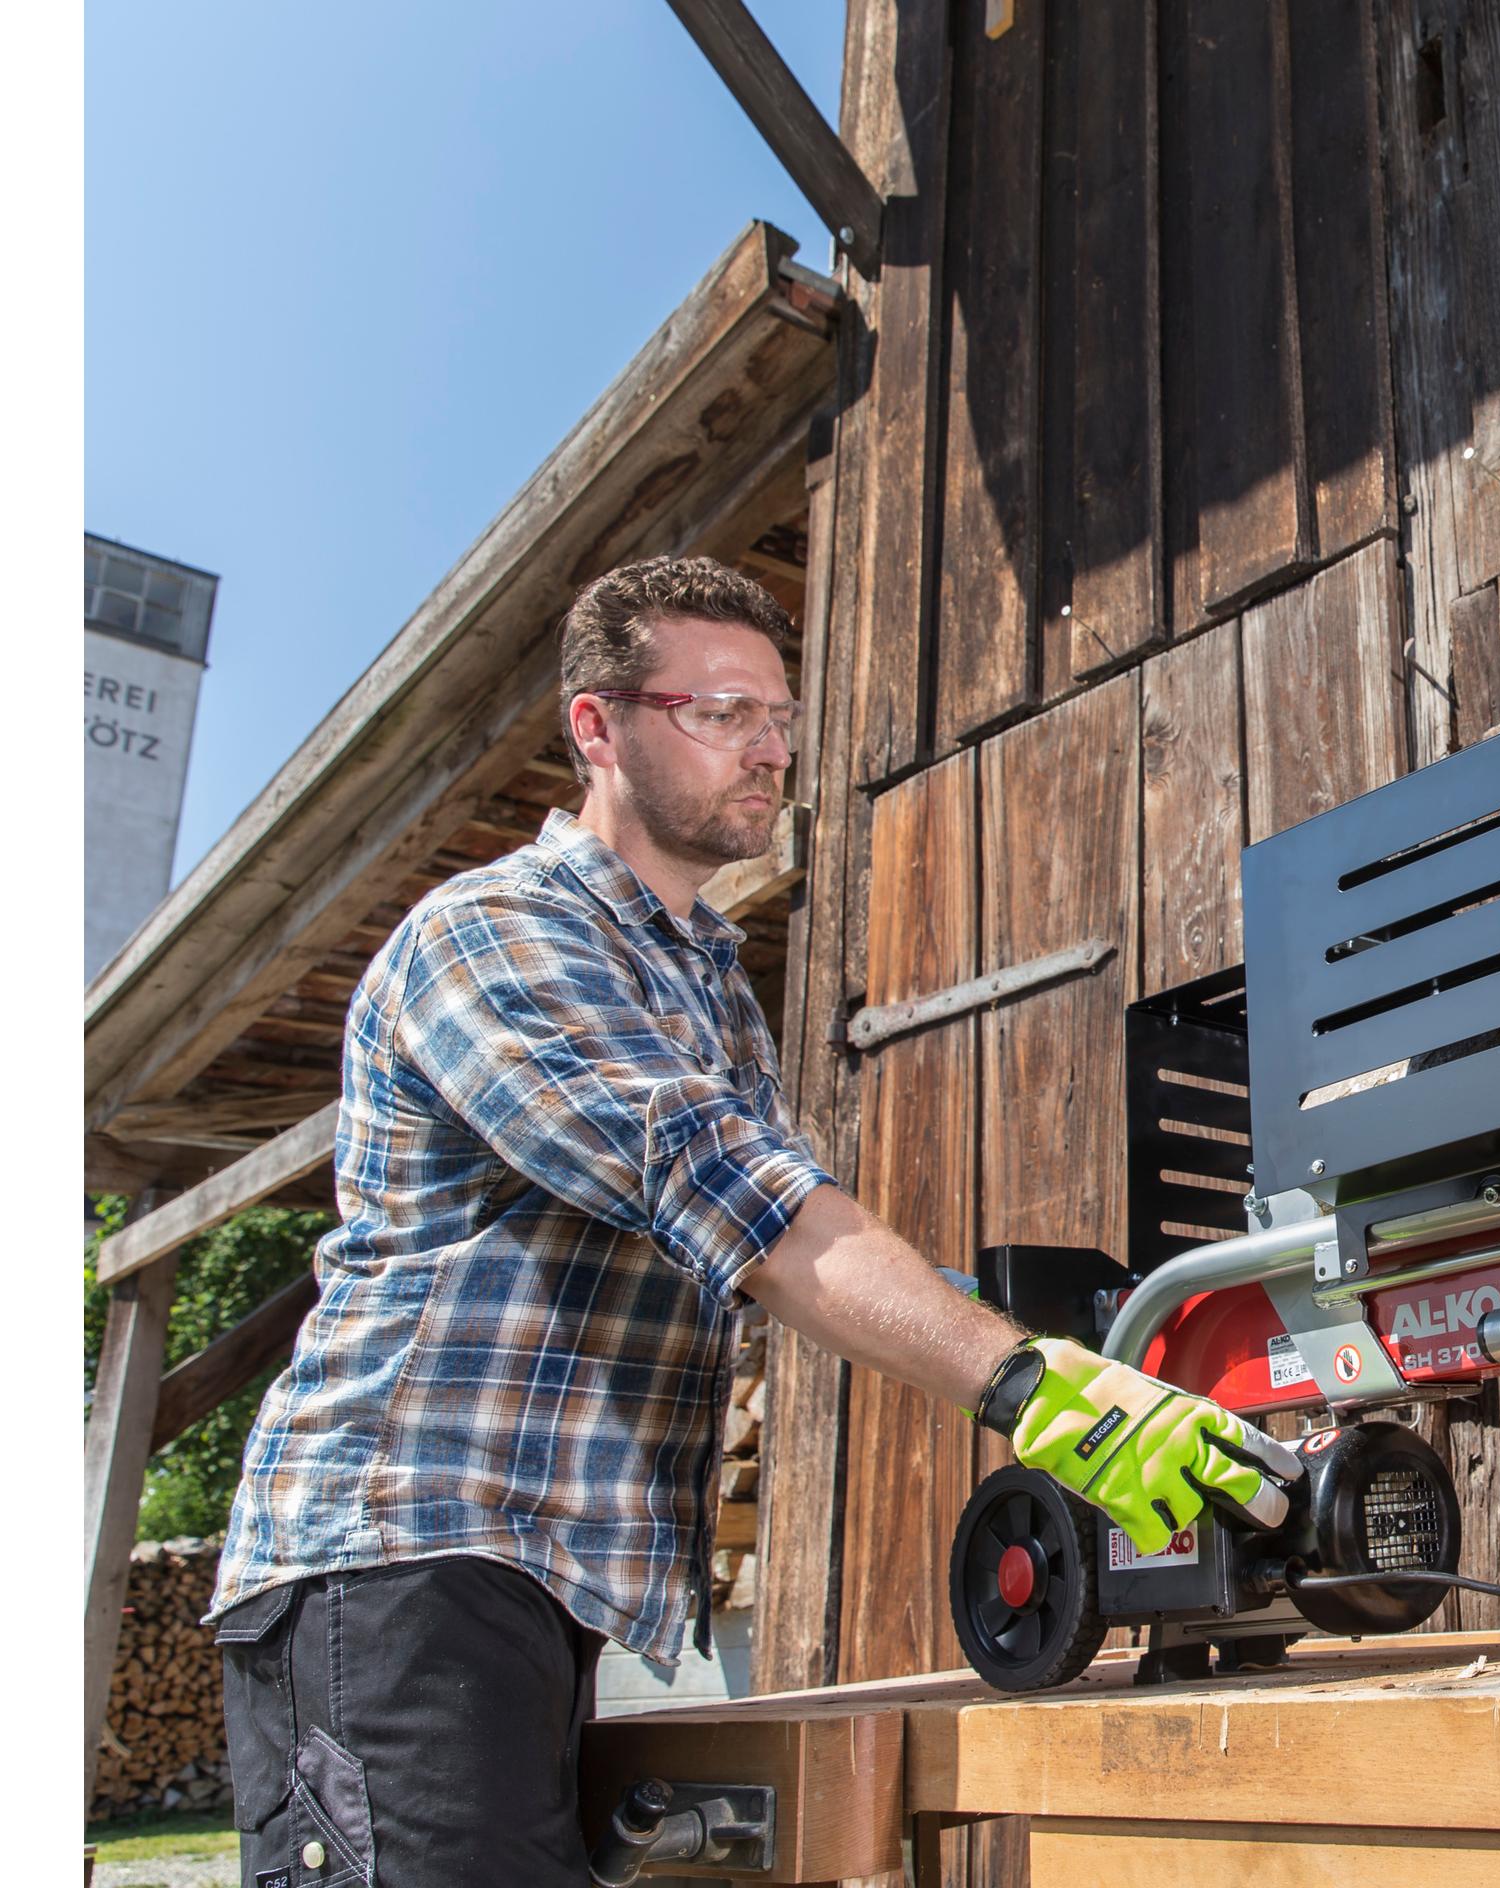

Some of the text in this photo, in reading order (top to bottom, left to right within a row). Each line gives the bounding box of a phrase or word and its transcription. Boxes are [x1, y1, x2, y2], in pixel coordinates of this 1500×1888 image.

[84, 714, 162, 761] ÖTZ
[1400, 1342, 1480, 1371] SH 370
[265, 1876, 288, 1888] C52
